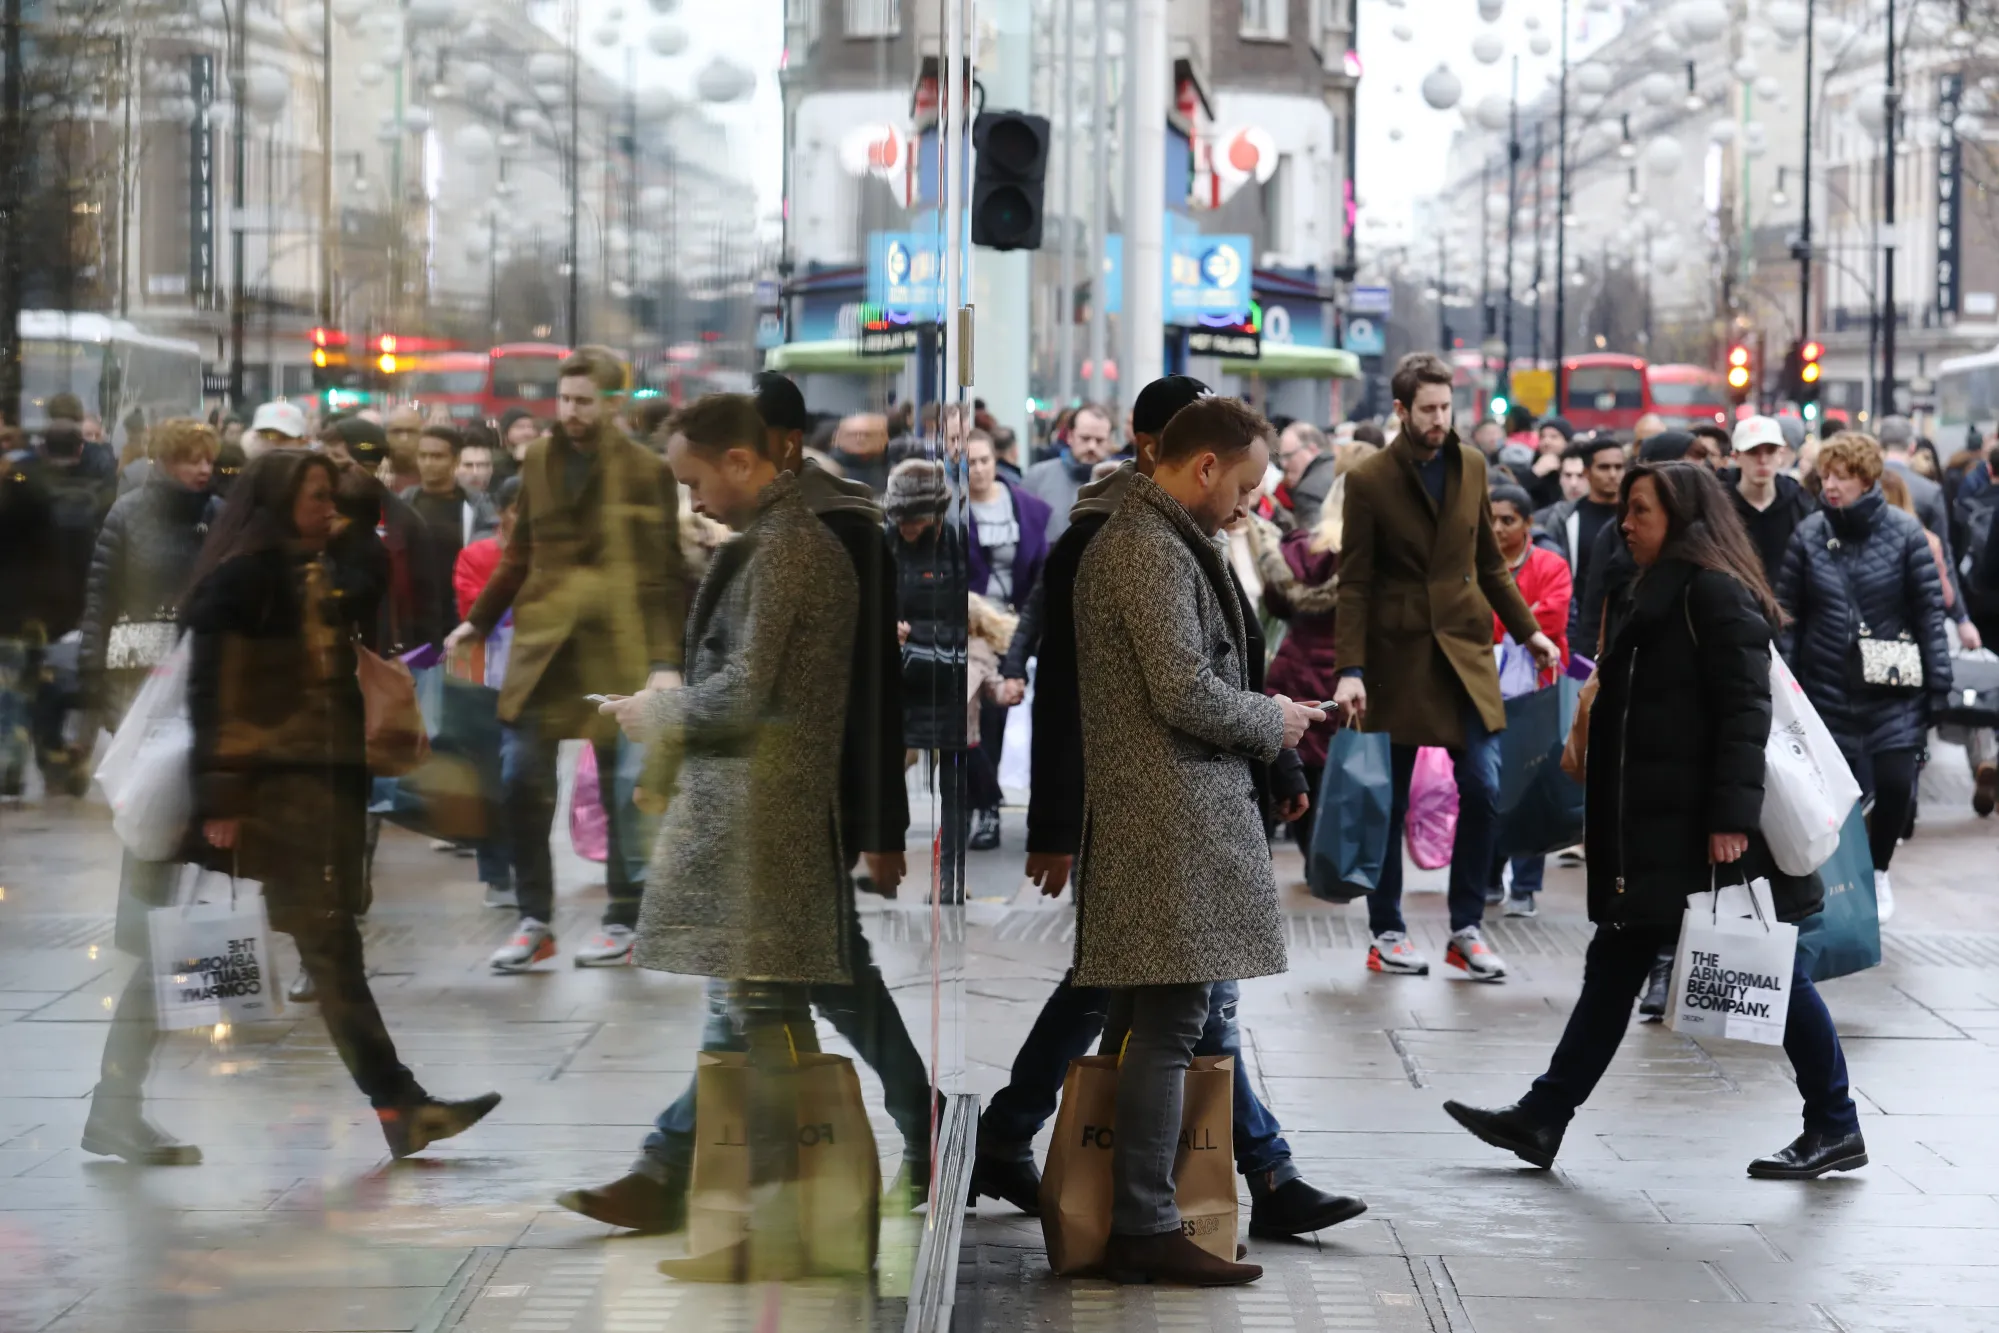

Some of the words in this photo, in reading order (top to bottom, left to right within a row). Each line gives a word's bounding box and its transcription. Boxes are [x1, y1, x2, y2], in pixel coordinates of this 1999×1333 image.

[1691, 951, 1719, 968] THE
[1687, 979, 1749, 1000] BEAUTY
[1689, 965, 1782, 991] ABNORMAL
[1685, 994, 1770, 1019] COMPANY.
